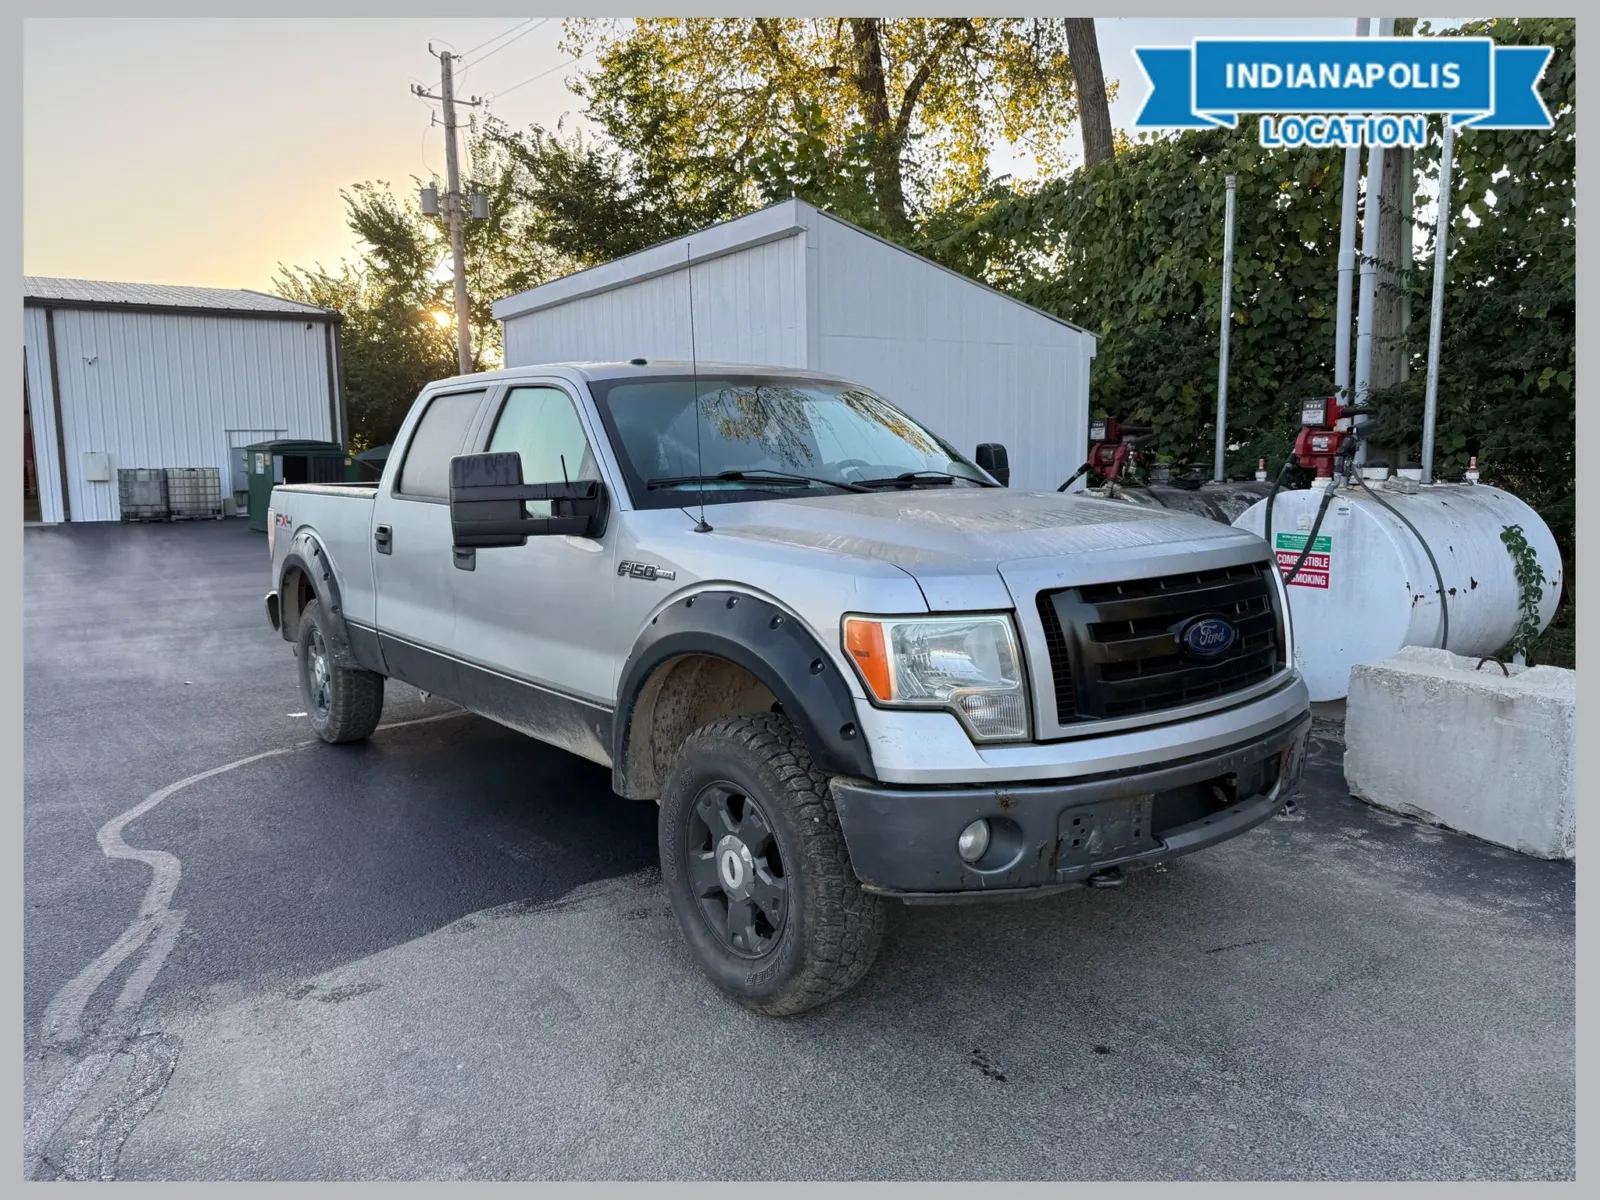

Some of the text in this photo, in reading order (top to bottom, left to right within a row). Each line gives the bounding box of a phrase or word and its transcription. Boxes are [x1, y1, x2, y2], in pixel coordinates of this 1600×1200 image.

[275, 513, 293, 528] FX4
[1276, 553, 1329, 568] COMBSTIBLE
[1199, 624, 1226, 646] Ford
